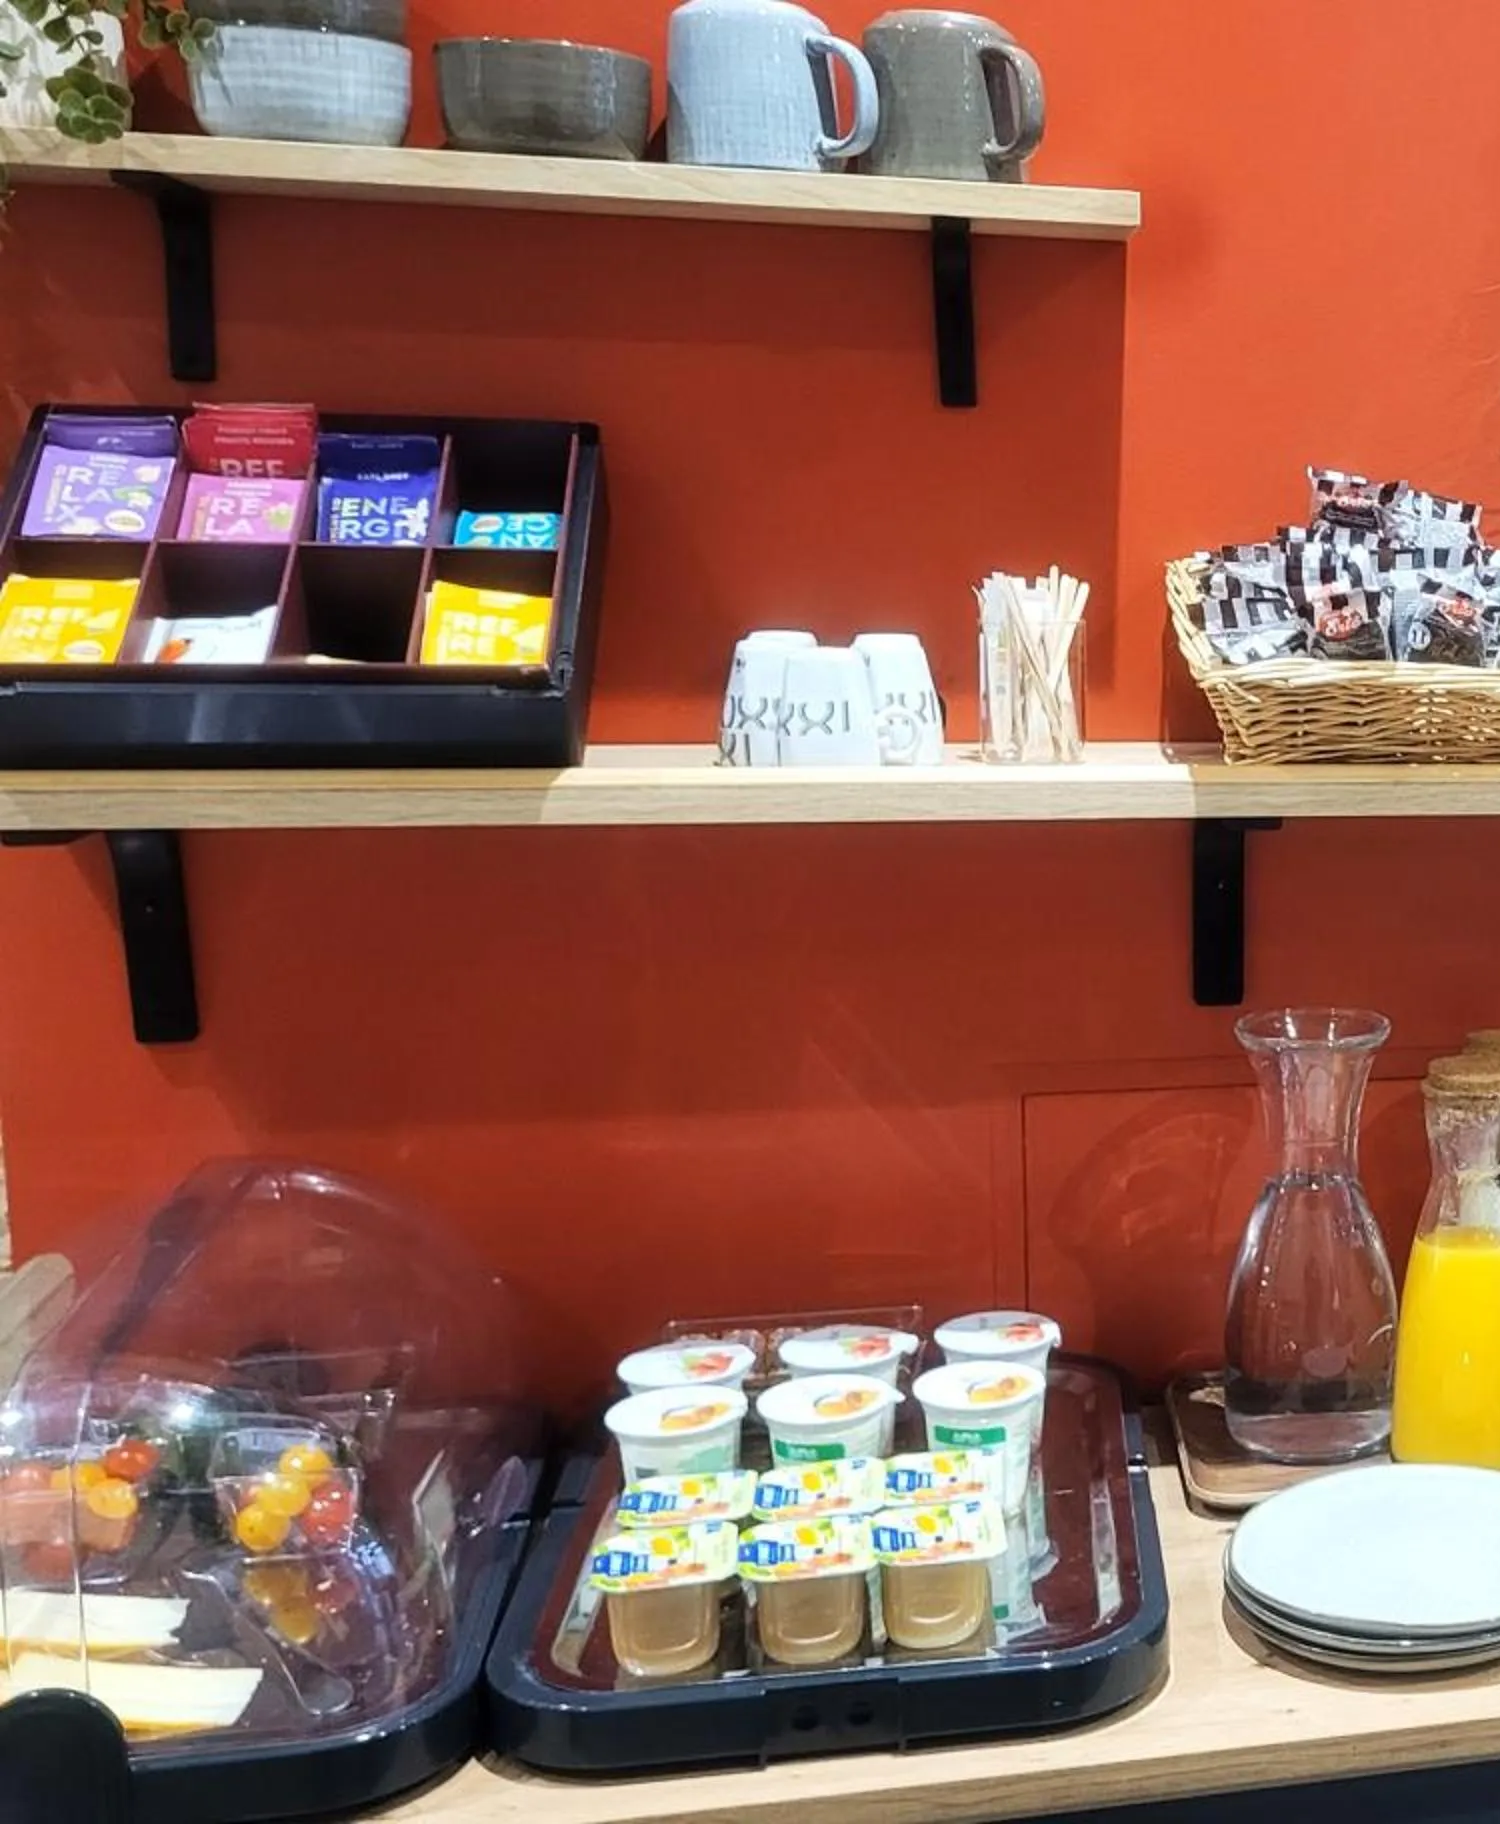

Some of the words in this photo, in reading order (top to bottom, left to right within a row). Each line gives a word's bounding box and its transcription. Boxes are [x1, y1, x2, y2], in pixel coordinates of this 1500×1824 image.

[66, 465, 122, 486] RE
[61, 484, 113, 504] LA
[55, 503, 84, 524] X
[209, 497, 262, 516] RE
[340, 497, 410, 517] ENE
[204, 516, 255, 536] LA
